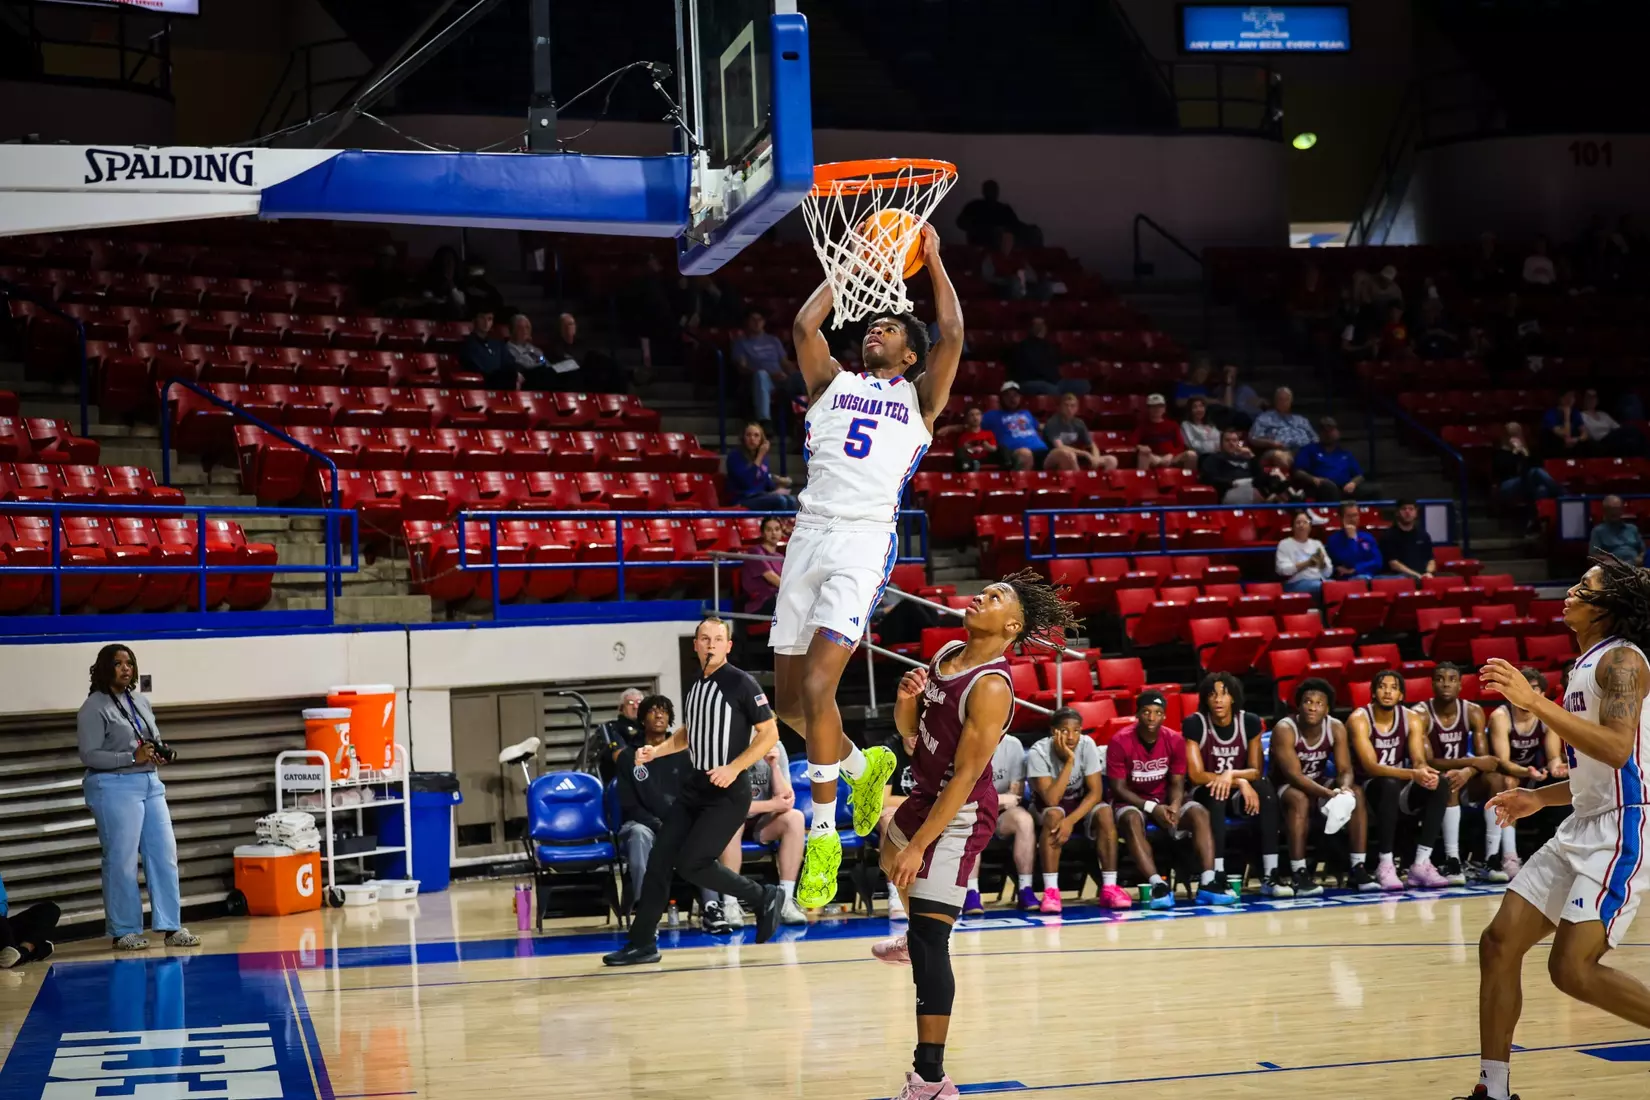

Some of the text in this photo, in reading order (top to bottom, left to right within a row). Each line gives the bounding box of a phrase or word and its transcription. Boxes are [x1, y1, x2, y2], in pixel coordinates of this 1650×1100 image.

[84, 148, 253, 187] SPALDING
[1568, 140, 1613, 168] 101
[830, 393, 910, 425] LOUISIANA TECH
[843, 416, 879, 460] 5
[1214, 756, 1235, 774] 35
[1379, 747, 1396, 765] 24
[1444, 743, 1460, 759] 21
[283, 772, 322, 781] GATORADE
[296, 862, 314, 897] G
